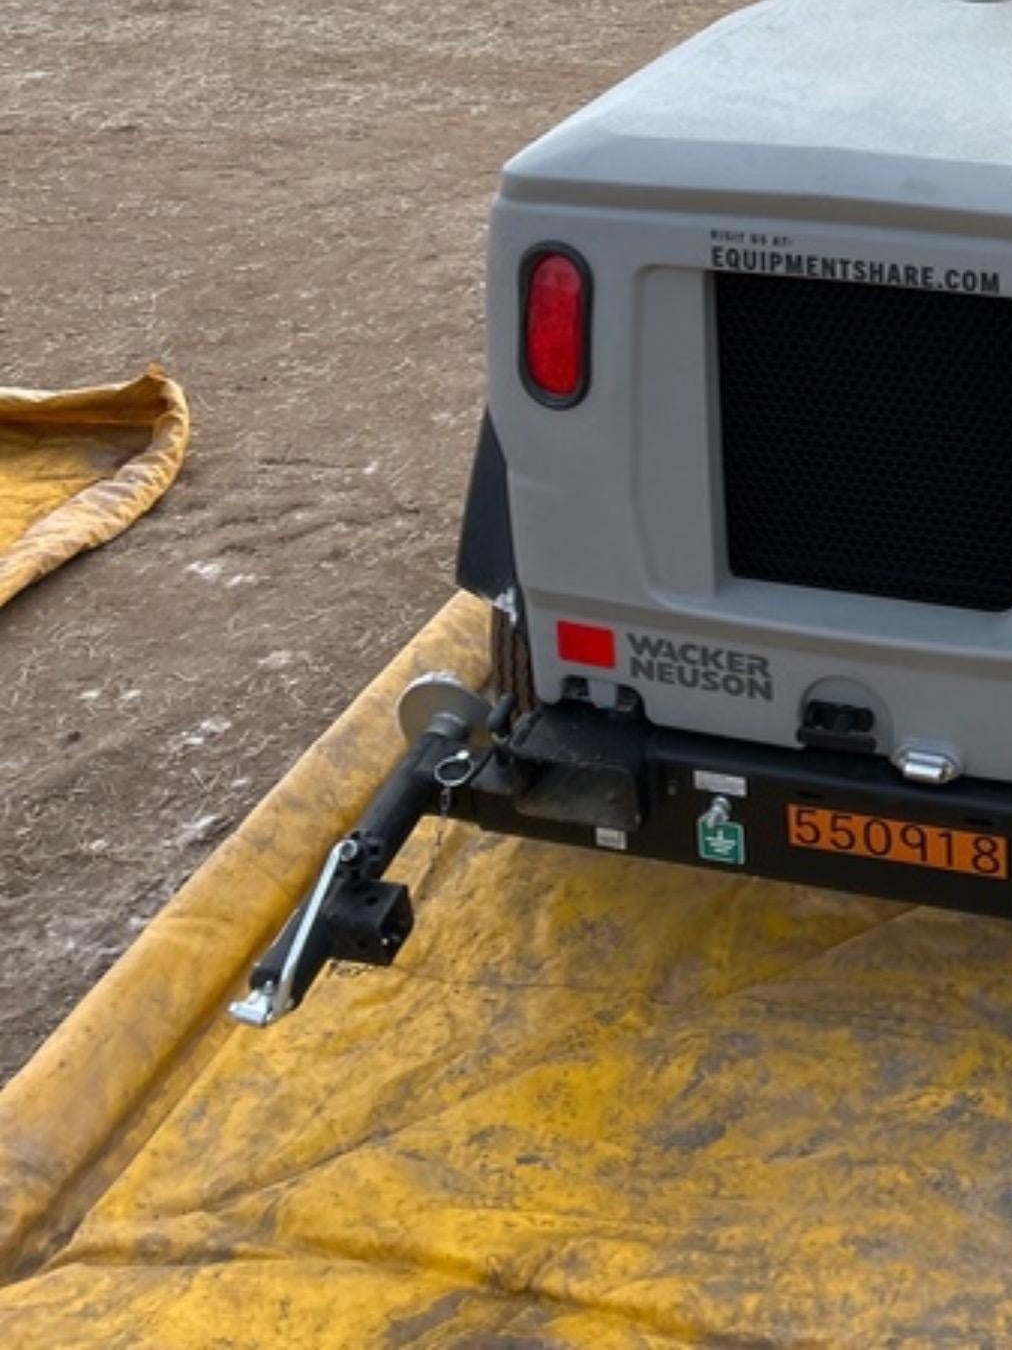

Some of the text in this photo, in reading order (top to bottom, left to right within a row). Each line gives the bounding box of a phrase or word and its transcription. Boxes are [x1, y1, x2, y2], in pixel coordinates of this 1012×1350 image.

[711, 246, 1000, 293] EQUIPMENTSHARE.COM
[626, 632, 772, 679] WACKER
[629, 657, 775, 702] NEUSON
[794, 808, 1000, 874] 550918
